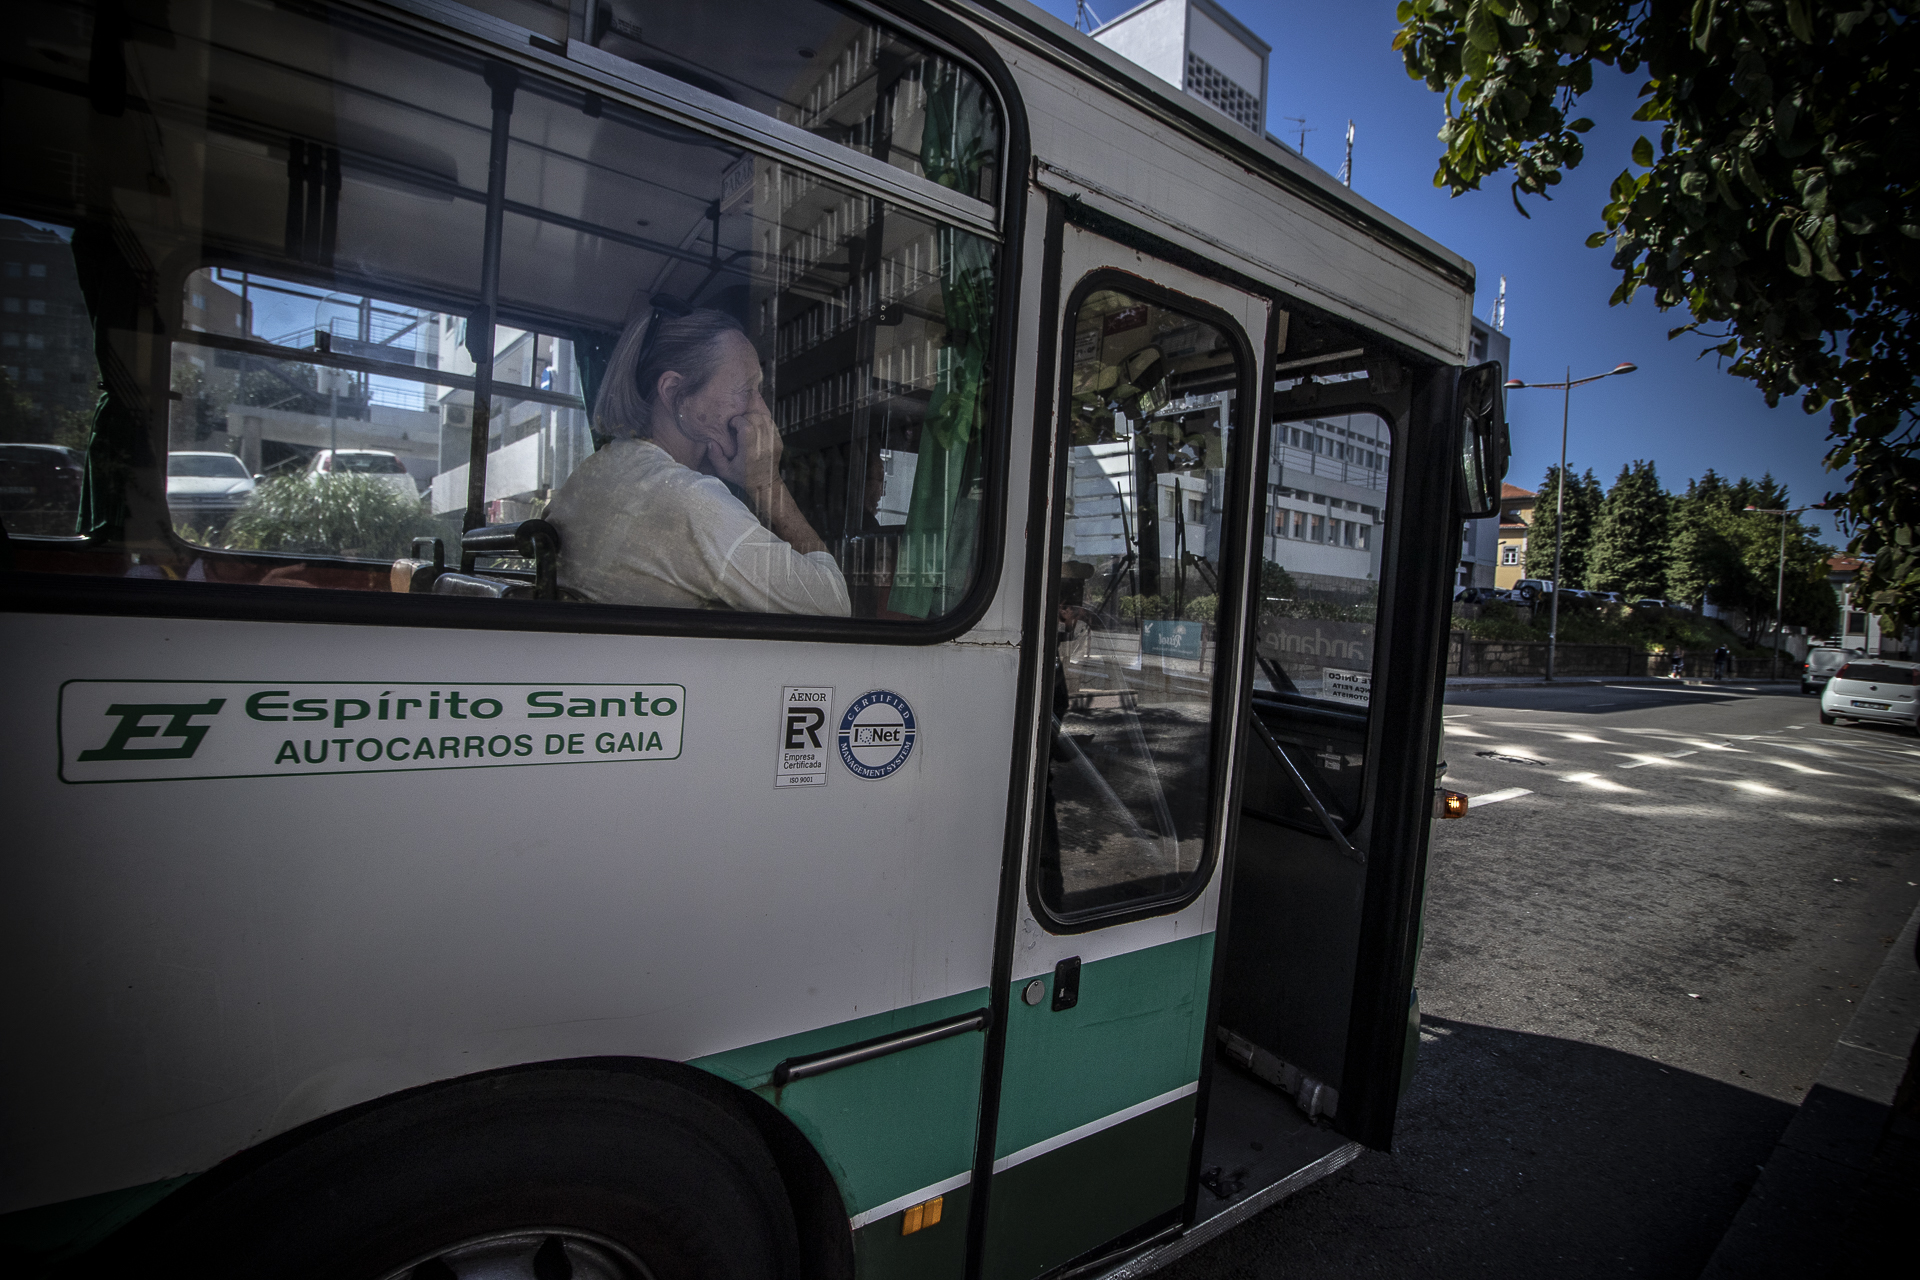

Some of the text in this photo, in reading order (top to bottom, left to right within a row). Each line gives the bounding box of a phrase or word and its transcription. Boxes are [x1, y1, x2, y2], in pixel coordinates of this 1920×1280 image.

[245, 690, 678, 728] Espírito Santo
[847, 694, 910, 721] CERTIFIED
[785, 707, 825, 749] ER
[853, 728, 900, 744] IQNet
[274, 731, 663, 764] AUTOCARROS DE GAIA
[784, 753, 815, 761] Empresa
[841, 741, 911, 777] MANAGEMENT SYSTEM
[783, 761, 822, 769] Certificada
